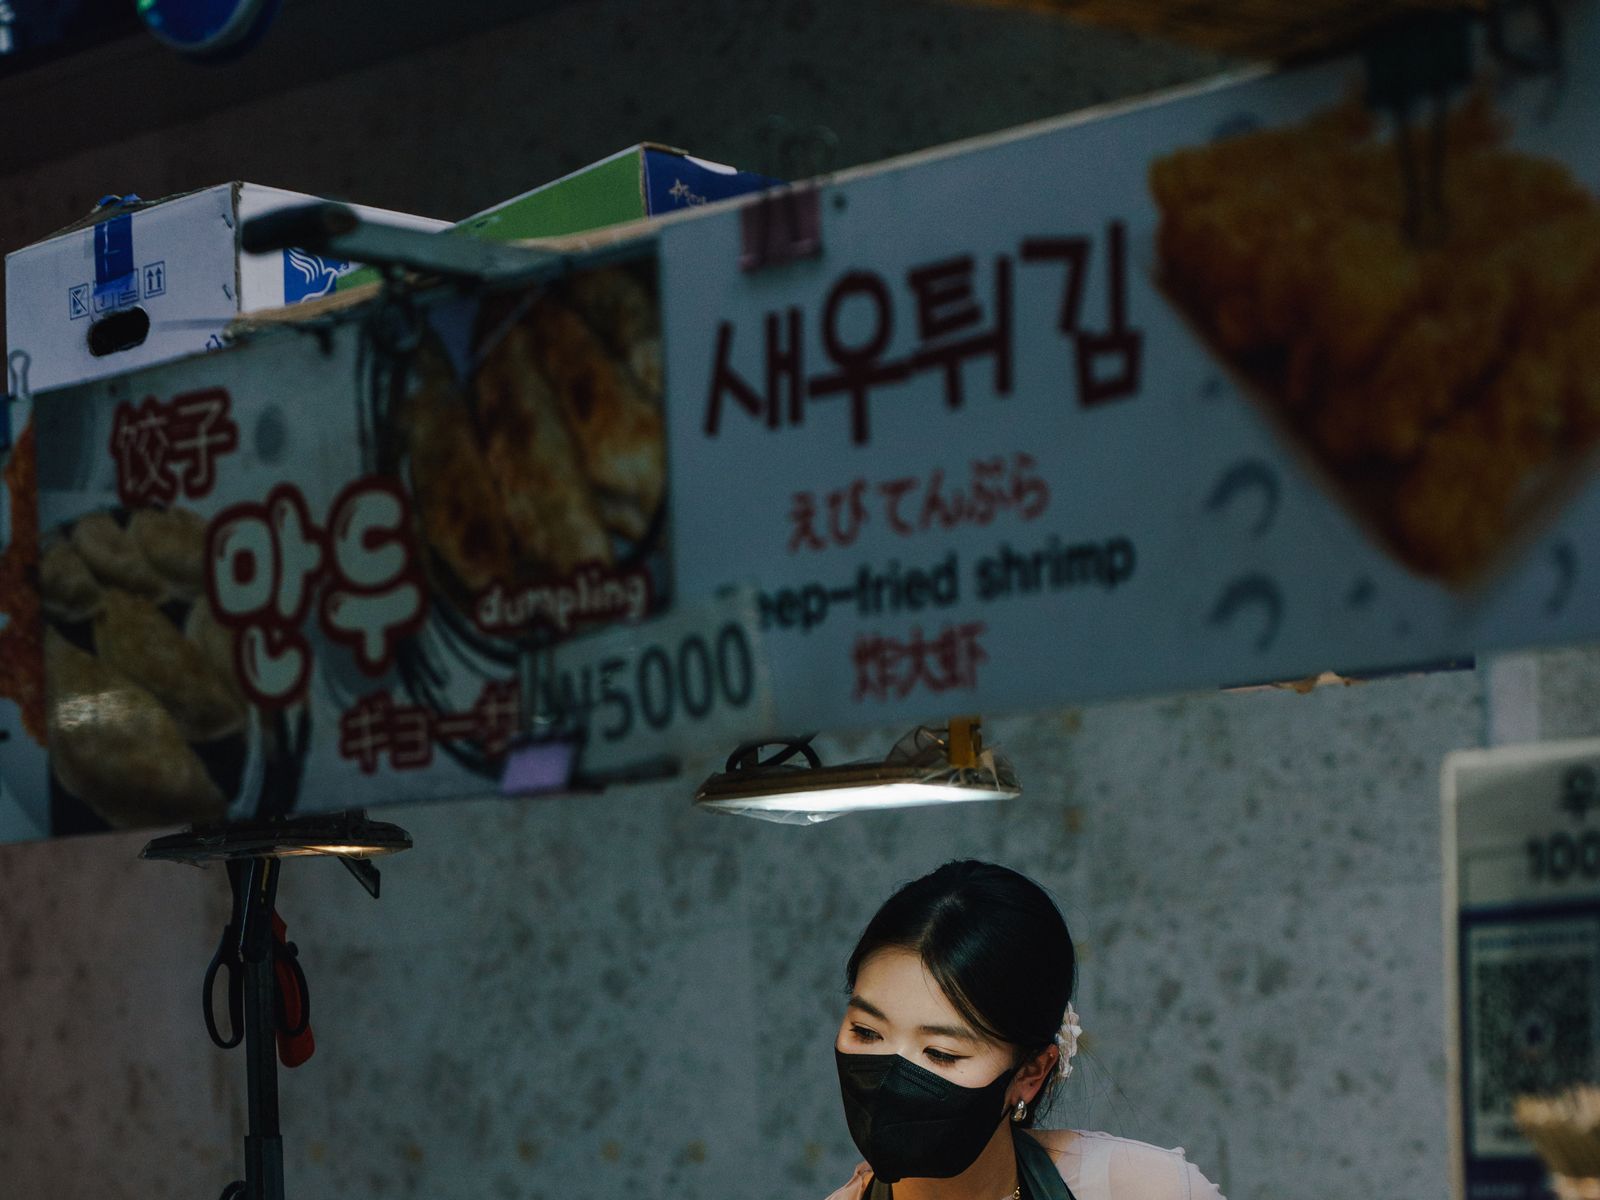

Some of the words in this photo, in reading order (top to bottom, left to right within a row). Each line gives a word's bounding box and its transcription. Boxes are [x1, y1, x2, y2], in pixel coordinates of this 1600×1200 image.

[704, 218, 1146, 446] 새우튀김
[205, 479, 425, 708] 만두
[477, 566, 651, 635] dumpling
[975, 533, 1136, 599] shrimp
